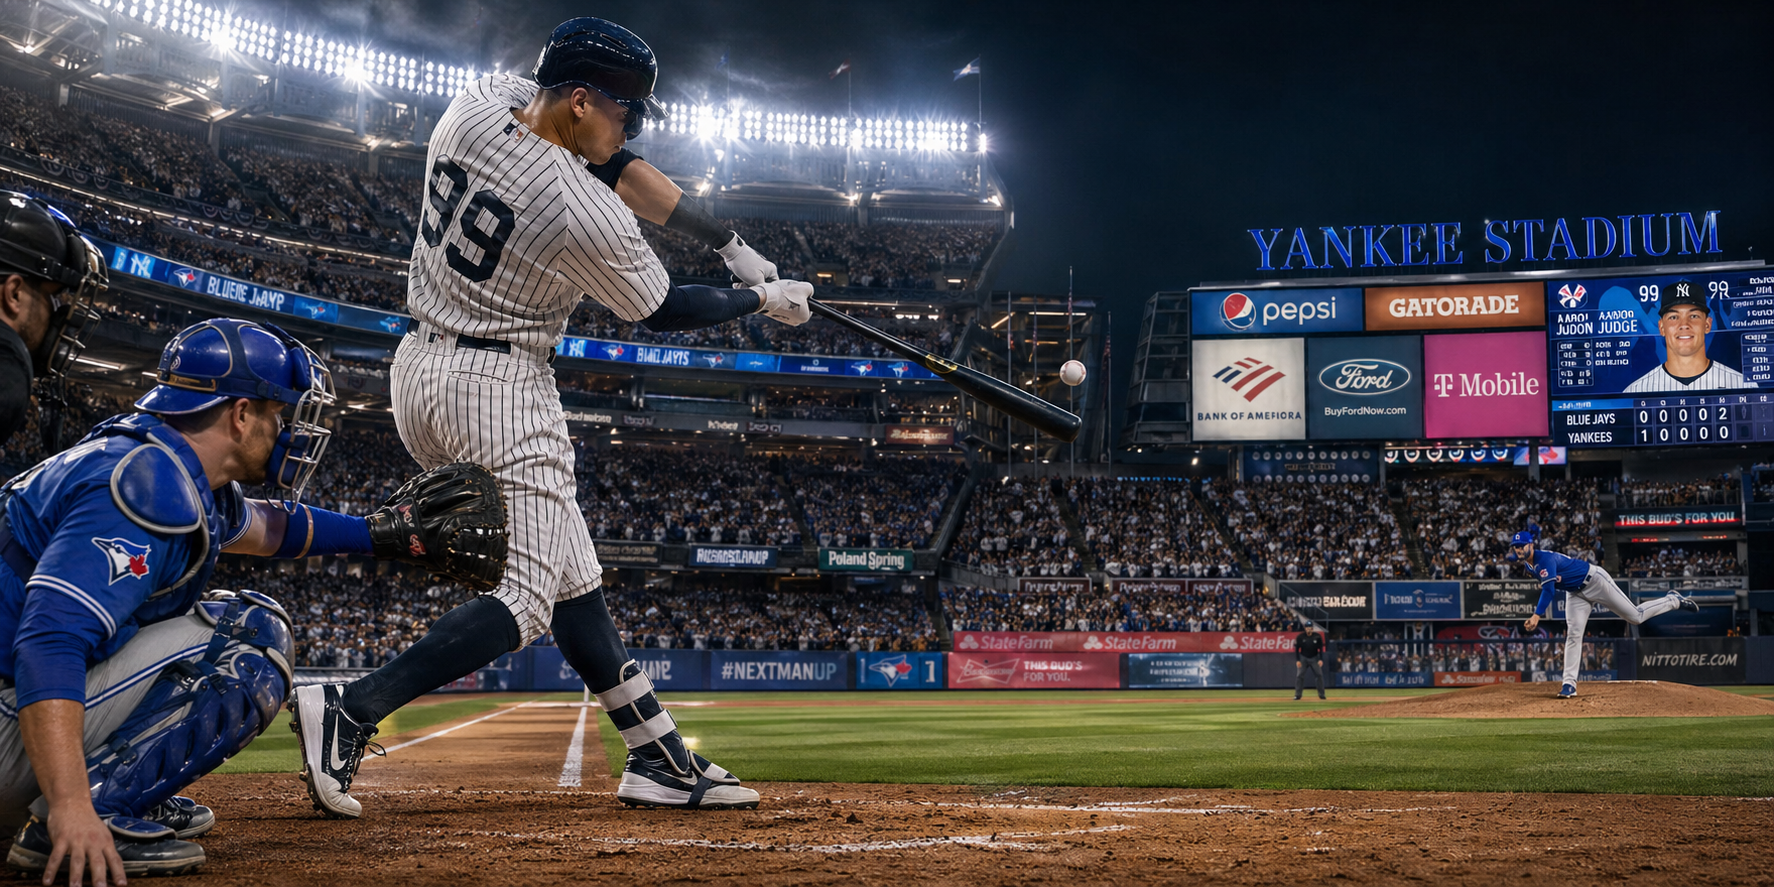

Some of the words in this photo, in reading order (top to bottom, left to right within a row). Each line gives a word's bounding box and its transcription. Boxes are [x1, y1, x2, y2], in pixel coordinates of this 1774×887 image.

[421, 153, 516, 283] 99
[1247, 222, 1463, 271] YANKEE
[1484, 210, 1723, 263] STADIUM
[1639, 284, 1659, 302] 99
[1263, 297, 1336, 326] pepsi
[1388, 295, 1520, 318] GATORADE
[1598, 320, 1638, 334] JUDGE
[1335, 364, 1394, 390] Ford
[1459, 372, 1539, 397] Mobile
[1197, 412, 1228, 421] BANK
[1230, 412, 1245, 420] OF
[1324, 406, 1407, 417] BuyFordNow.com
[1567, 415, 1591, 425] BLUE
[1592, 413, 1616, 424] JAYS
[1640, 411, 1648, 423] 0
[1659, 409, 1668, 423] 0
[1679, 408, 1688, 422] 0
[1699, 408, 1707, 421] 0
[1719, 407, 1727, 420] 2
[1568, 432, 1613, 443] YANKEES
[1641, 429, 1647, 442] 1
[1660, 428, 1668, 442] 0
[1680, 427, 1688, 440] 0
[1700, 426, 1708, 439] 0
[1719, 426, 1728, 439] 0
[1648, 513, 1683, 525] BUD'S
[1685, 512, 1708, 524] FOR
[1710, 511, 1735, 523] YOU
[828, 550, 867, 566] Poland
[868, 551, 904, 570] Spring
[721, 661, 837, 681] #NEXTMANUP
[1023, 660, 1048, 670] THIS
[1023, 671, 1045, 682] FOR
[1046, 671, 1071, 682] YOU.
